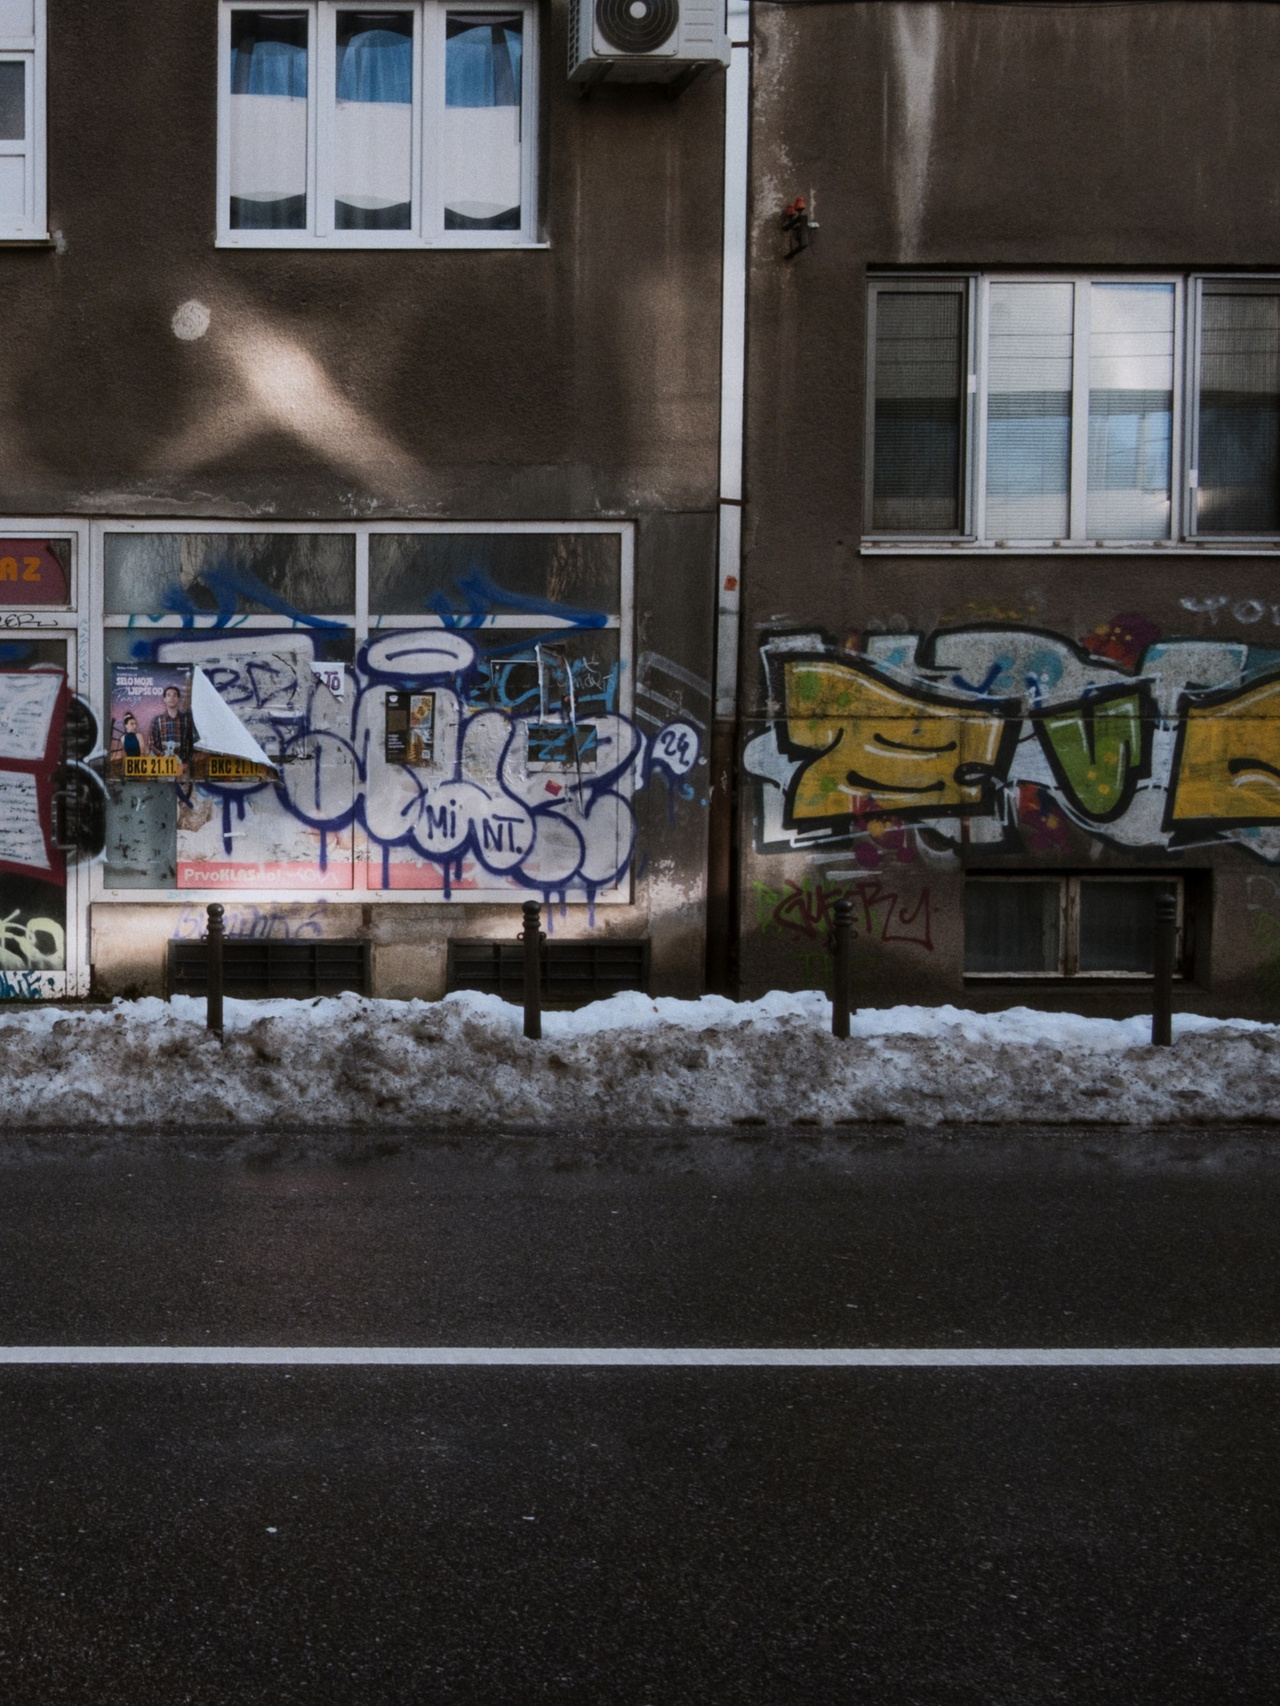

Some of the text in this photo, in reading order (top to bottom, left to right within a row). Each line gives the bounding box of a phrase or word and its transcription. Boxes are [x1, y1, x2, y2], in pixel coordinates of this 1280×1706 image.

[116, 677, 153, 686] SELO MOJE
[152, 687, 164, 696] OD
[127, 759, 177, 774] BKC 21.11.
[211, 759, 231, 774] BKC
